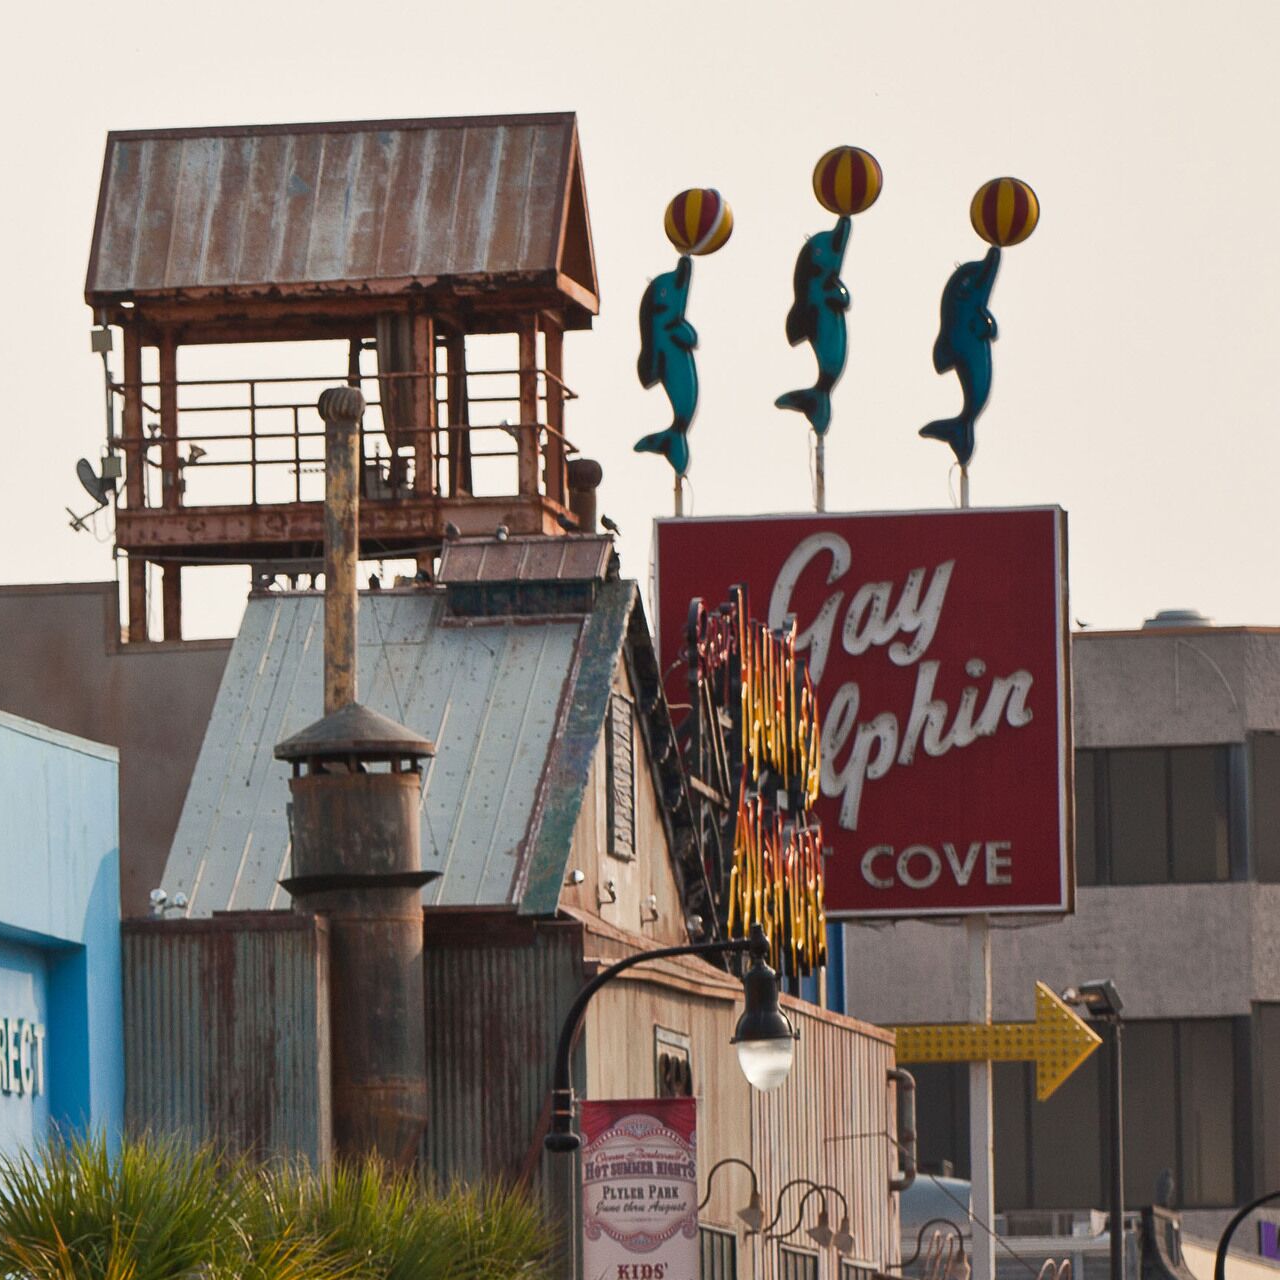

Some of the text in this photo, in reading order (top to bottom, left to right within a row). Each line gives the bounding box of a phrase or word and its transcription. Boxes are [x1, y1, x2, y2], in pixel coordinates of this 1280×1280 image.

[767, 532, 955, 686] Gay
[820, 658, 1034, 831] lphin
[860, 840, 1013, 890] COVE
[585, 1160, 696, 1180] HOT SUMMER NIGHTS
[602, 1184, 679, 1200] PLYLER PARK
[595, 1200, 687, 1216] June thru August
[617, 1262, 668, 1280] KIDS'
